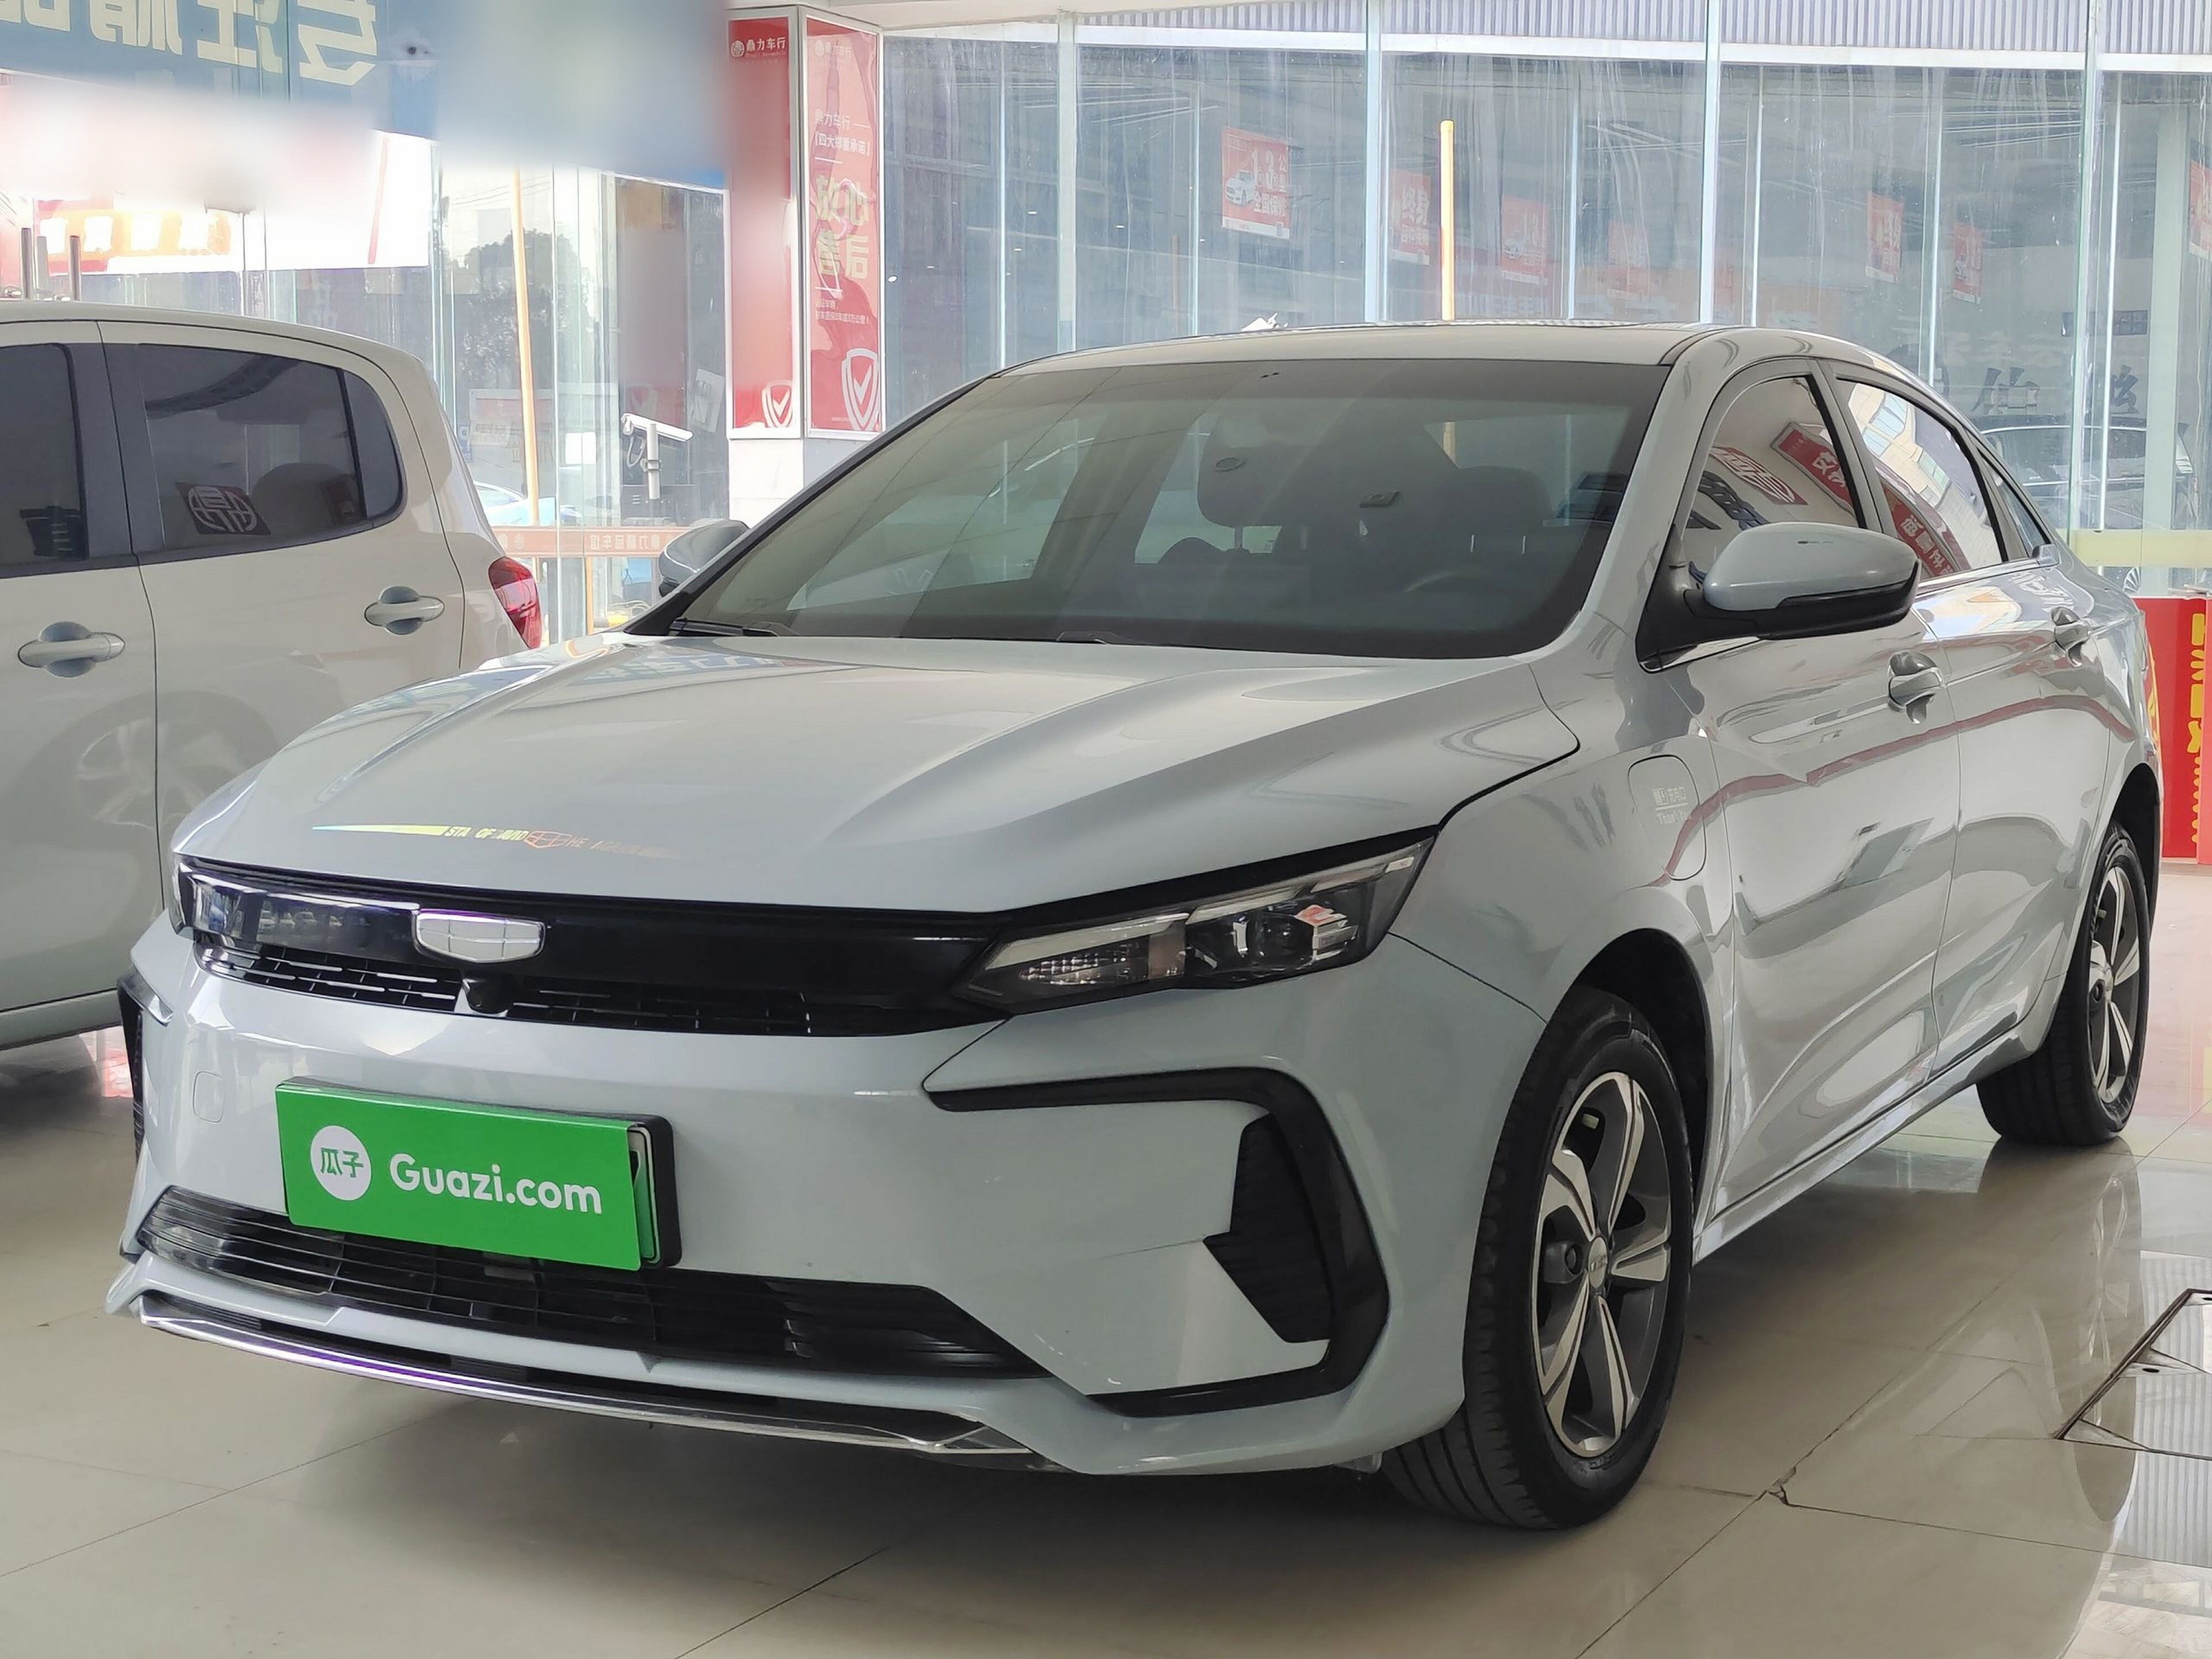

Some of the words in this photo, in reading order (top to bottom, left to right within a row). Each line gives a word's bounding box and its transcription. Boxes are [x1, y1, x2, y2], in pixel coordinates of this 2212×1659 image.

[817, 229, 869, 279] 售后
[320, 1147, 364, 1179] 瓜子
[389, 1153, 602, 1214] Guazi.com
